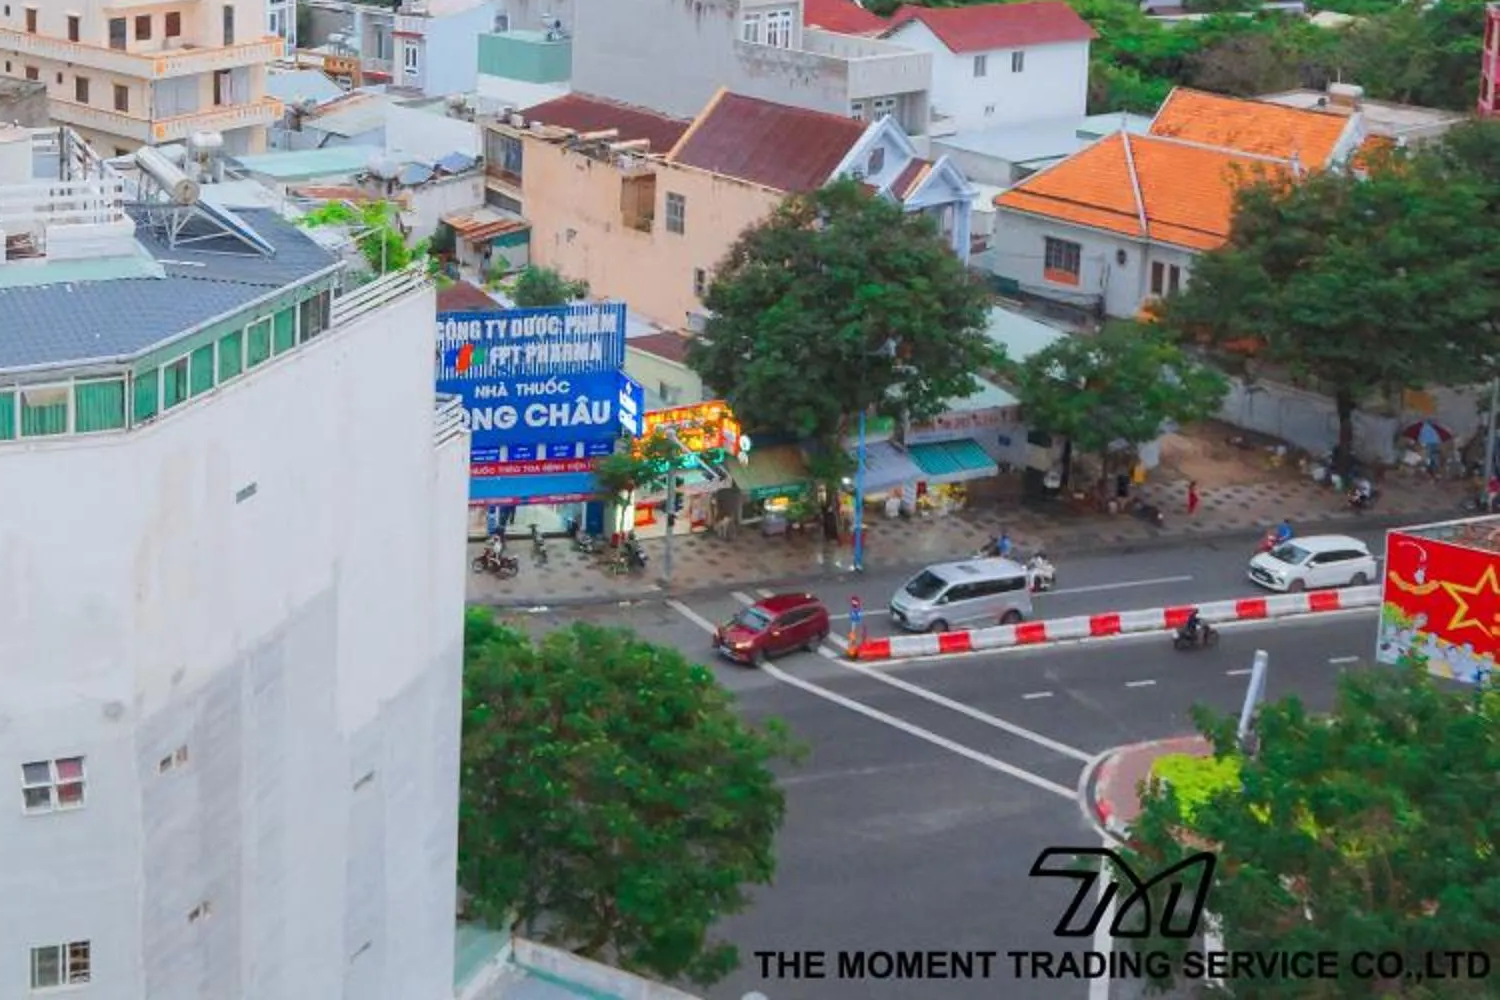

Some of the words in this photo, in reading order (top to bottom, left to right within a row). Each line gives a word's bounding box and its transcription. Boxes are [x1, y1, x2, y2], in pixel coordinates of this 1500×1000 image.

[485, 318, 508, 339] TY
[488, 345, 524, 366] FPT
[525, 342, 603, 365] PHARMA
[474, 381, 508, 399] NHÀ
[516, 375, 571, 397] THUỐC
[524, 396, 611, 428] CHÂU
